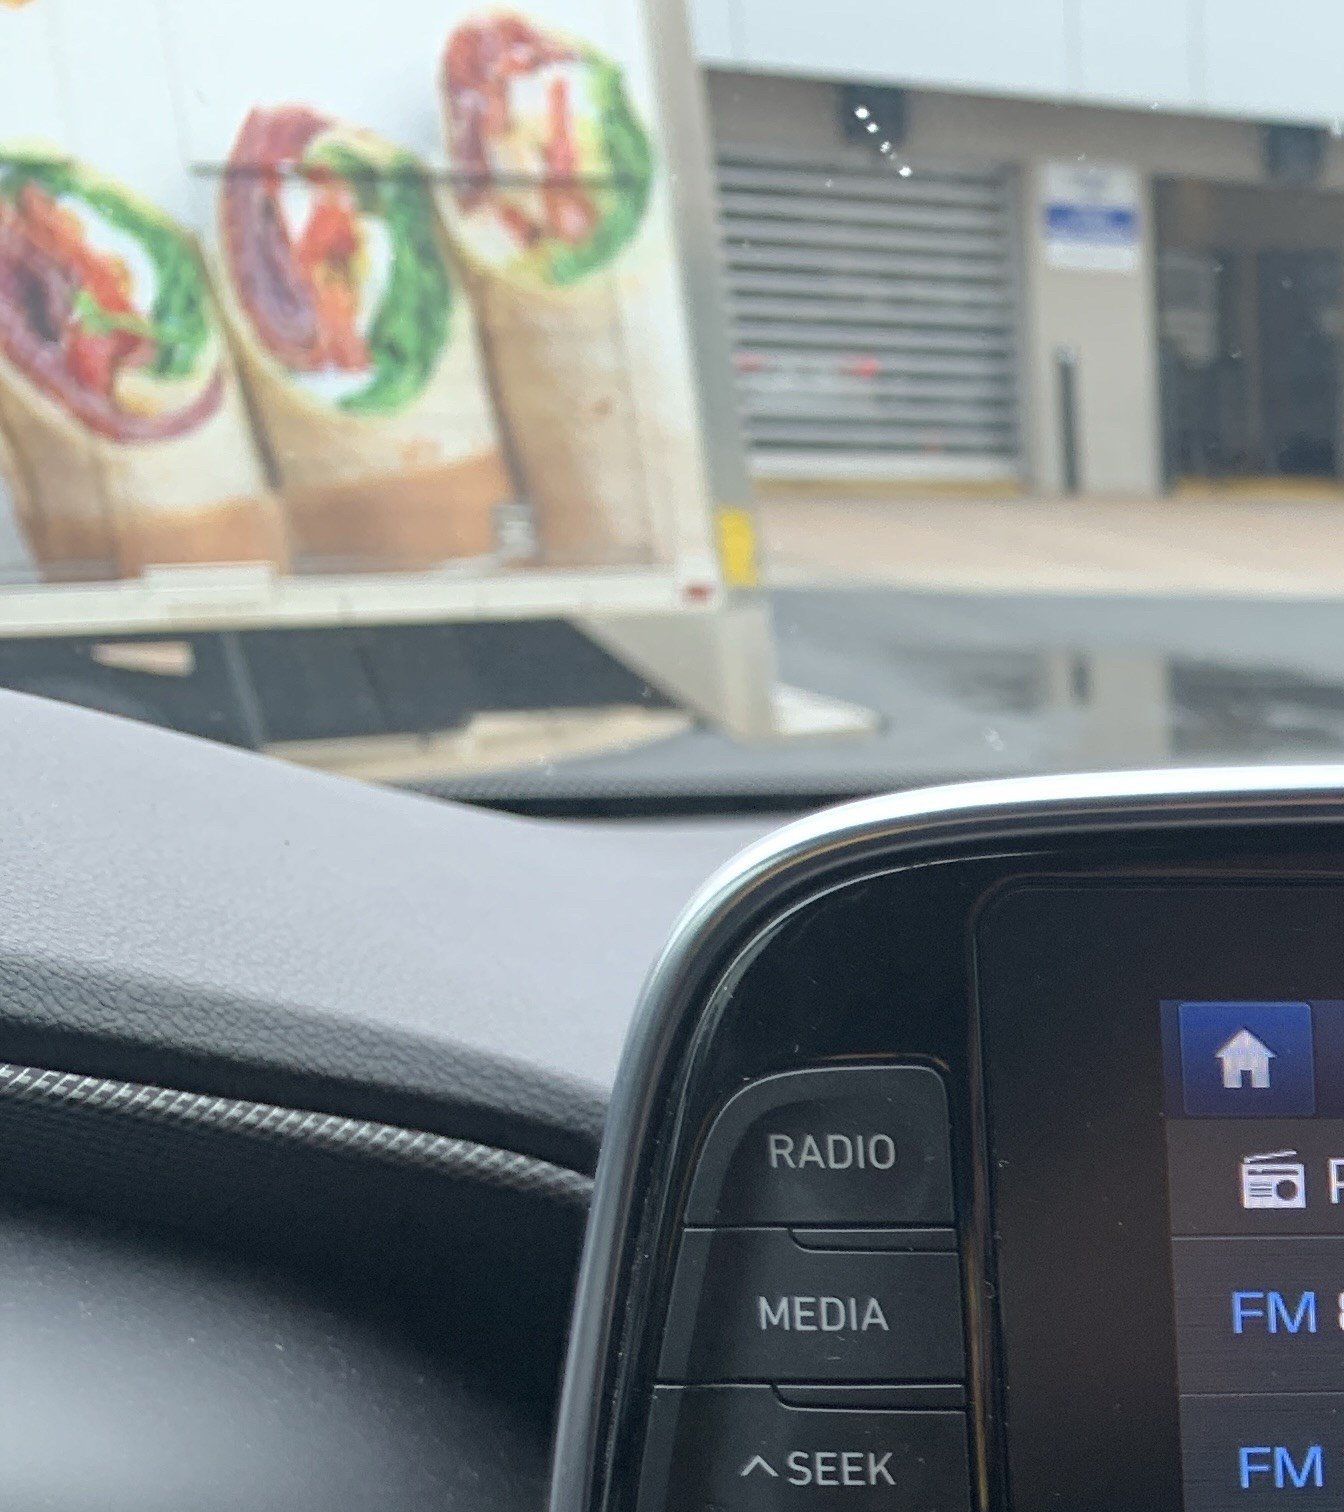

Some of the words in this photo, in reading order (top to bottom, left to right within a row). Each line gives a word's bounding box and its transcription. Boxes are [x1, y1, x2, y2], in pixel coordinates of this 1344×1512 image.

[769, 1133, 895, 1170] RADIO
[758, 1296, 889, 1332] MEDIA
[1232, 1291, 1317, 1334] FM
[786, 1450, 896, 1486] SEEK
[1239, 1445, 1323, 1488] FM
